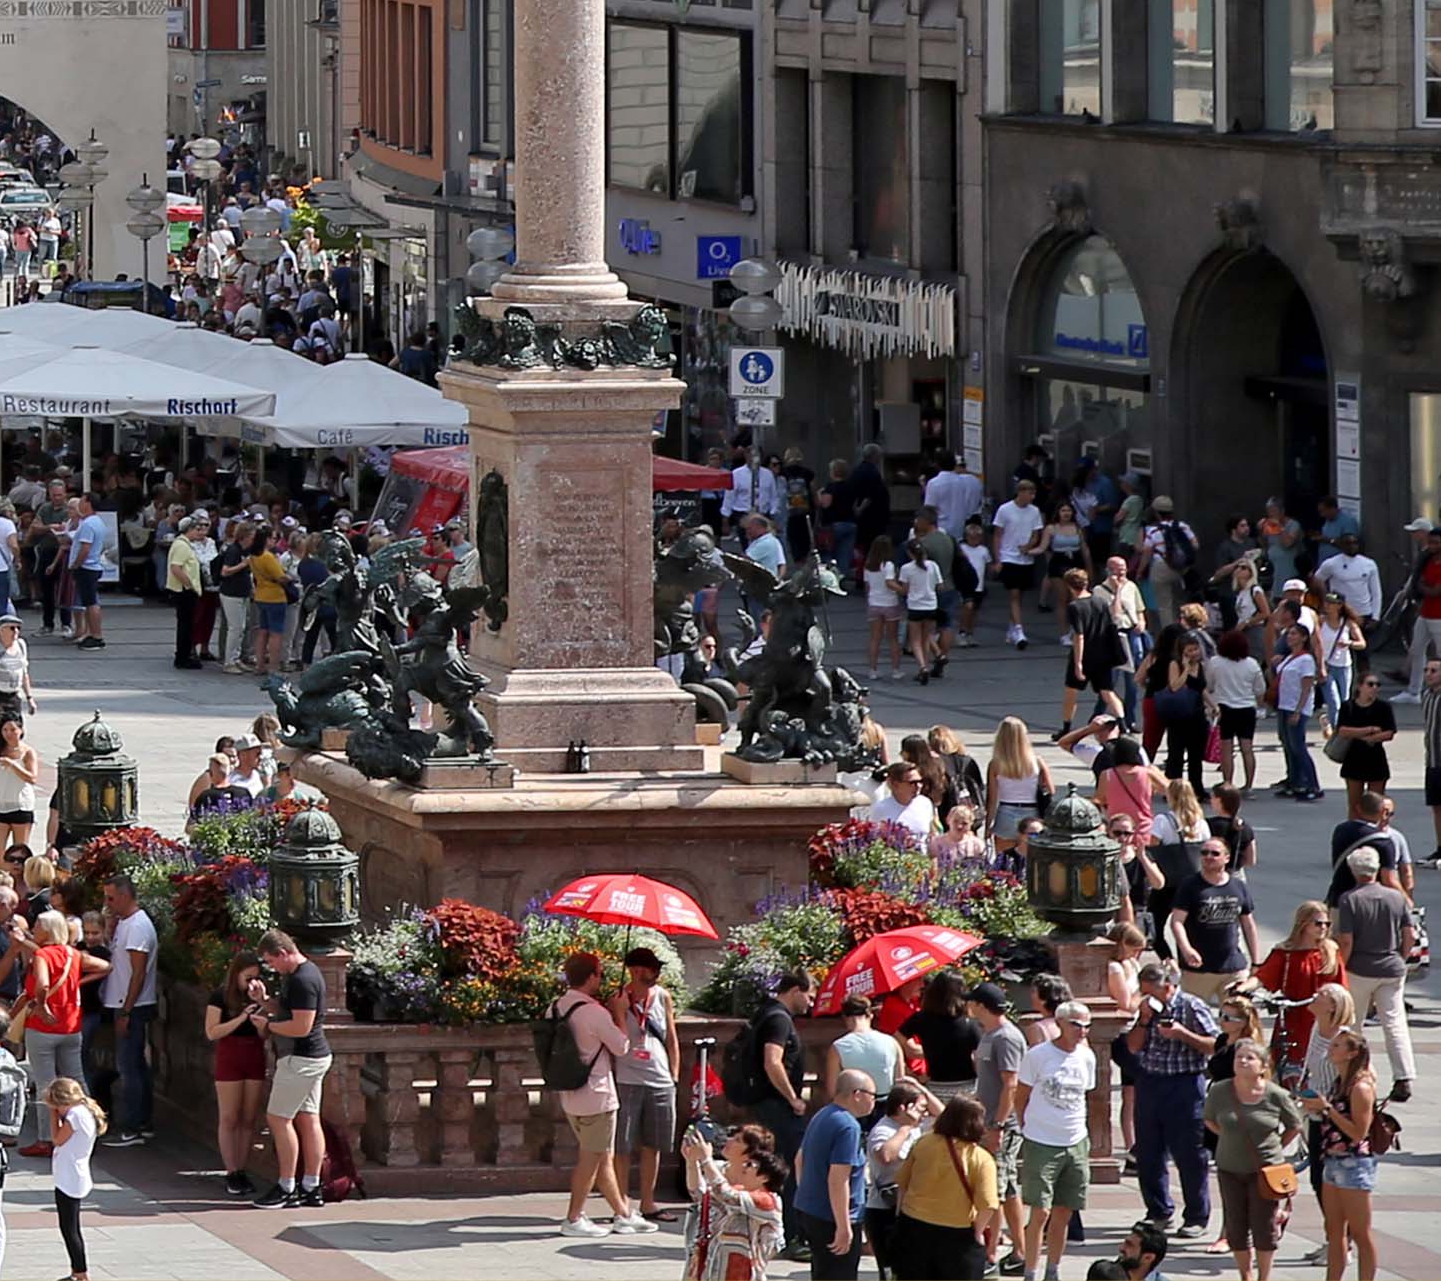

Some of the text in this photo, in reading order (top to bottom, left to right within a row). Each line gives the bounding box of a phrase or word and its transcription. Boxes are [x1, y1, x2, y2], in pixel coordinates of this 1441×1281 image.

[829, 293, 900, 327] SWAROVSKI
[743, 385, 769, 395] ZONE
[3, 395, 238, 416] Restaurant Rischart
[317, 428, 353, 446] Café
[611, 891, 646, 905] FREE
[611, 899, 646, 913] TOUR
[846, 968, 874, 987] FREE
